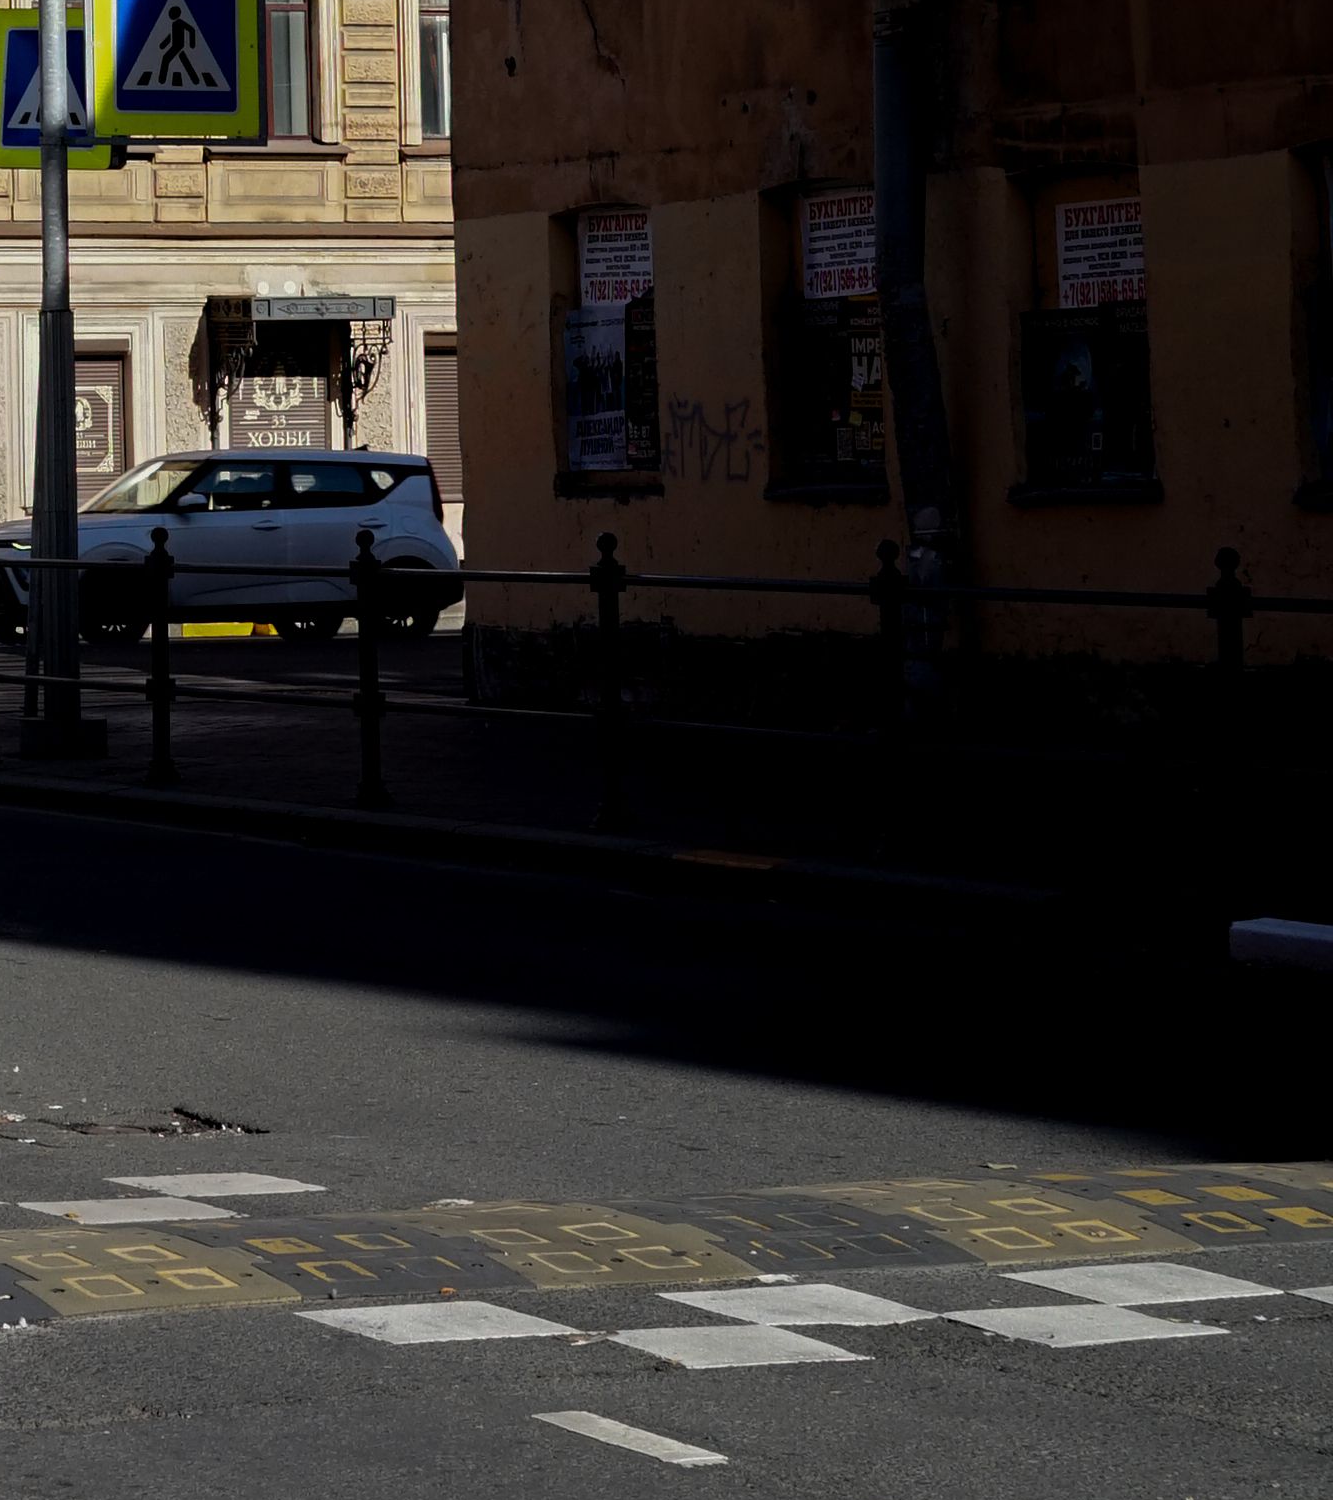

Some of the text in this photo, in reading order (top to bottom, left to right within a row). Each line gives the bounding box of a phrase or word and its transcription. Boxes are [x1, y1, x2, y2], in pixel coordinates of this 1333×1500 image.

[809, 195, 874, 220] БУХГАЛТЕР
[1064, 202, 1141, 228] БУХГАЛТЕР
[587, 213, 648, 233] БУХГАЛТЕР
[851, 337, 881, 353] IMPE
[271, 415, 286, 428] 33
[247, 431, 311, 447] ХОББИ
